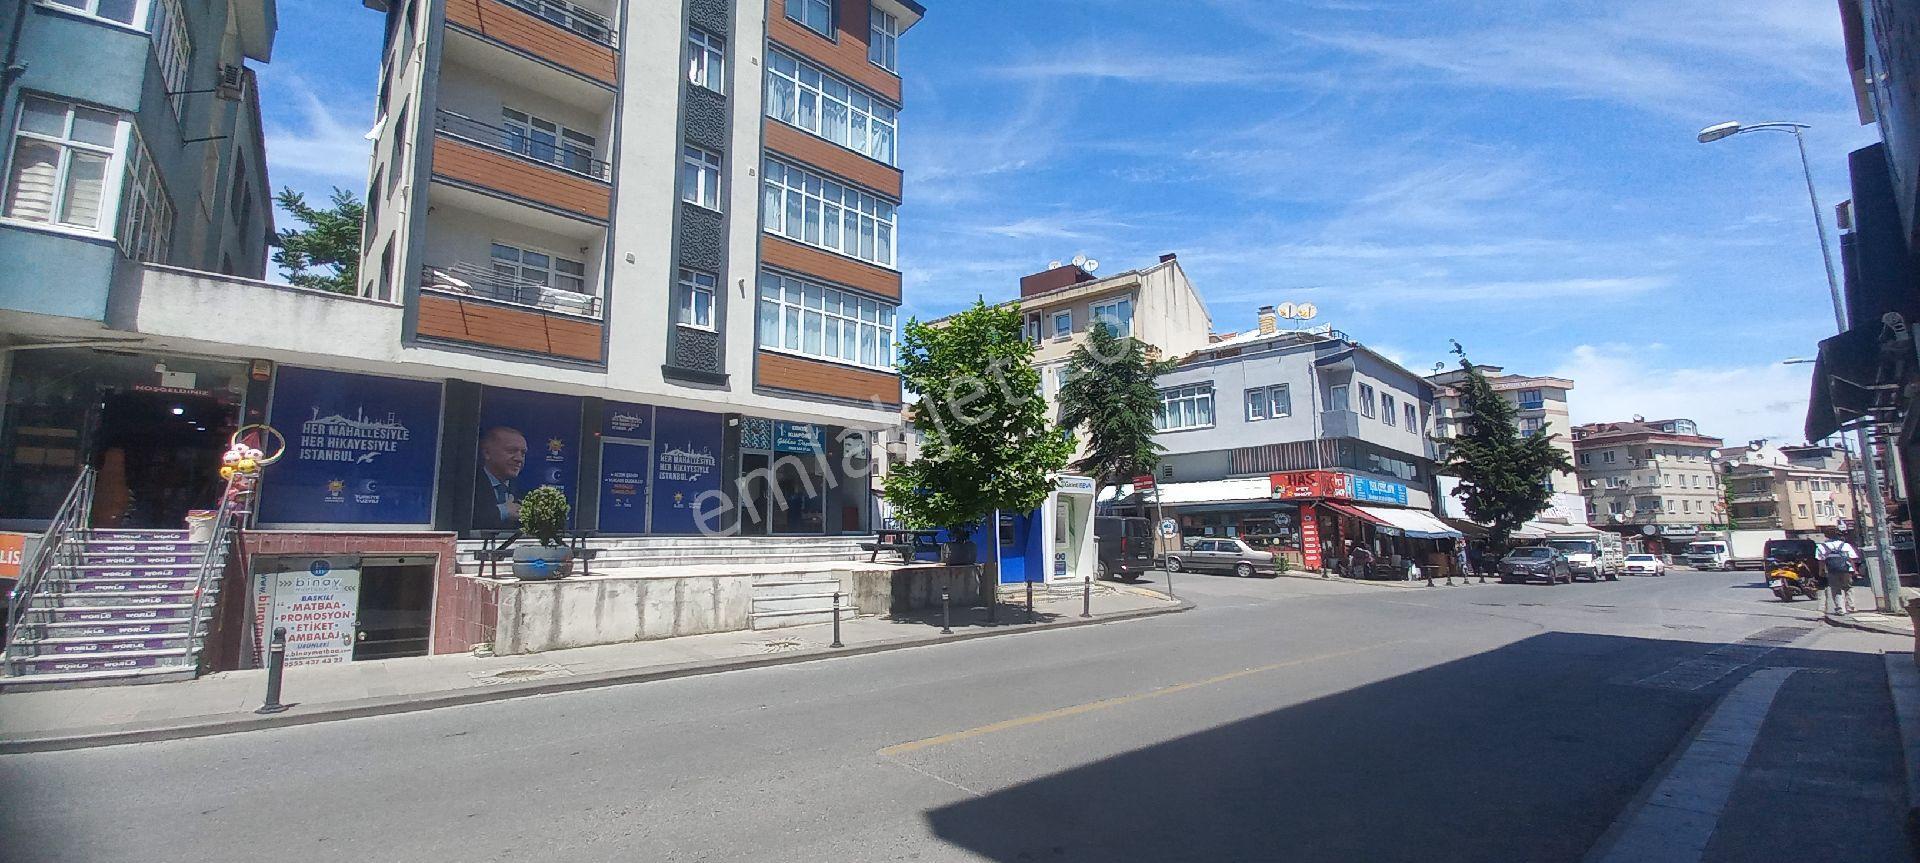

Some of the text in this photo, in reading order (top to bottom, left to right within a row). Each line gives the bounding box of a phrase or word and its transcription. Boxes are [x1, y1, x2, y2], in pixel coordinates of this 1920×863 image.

[302, 423, 410, 441] HER MAHALLESİYLE
[301, 435, 398, 452] HER HİKAYESİYLE
[300, 448, 354, 462] İSTANBUL
[659, 463, 672, 472] HER
[296, 577, 341, 587] binay
[292, 602, 341, 612] MATBAA
[281, 611, 350, 623] PROMOSYON
[296, 621, 334, 632] ETİKET
[288, 631, 340, 643] AMBALAJ
[104, 660, 137, 668] WORLD
